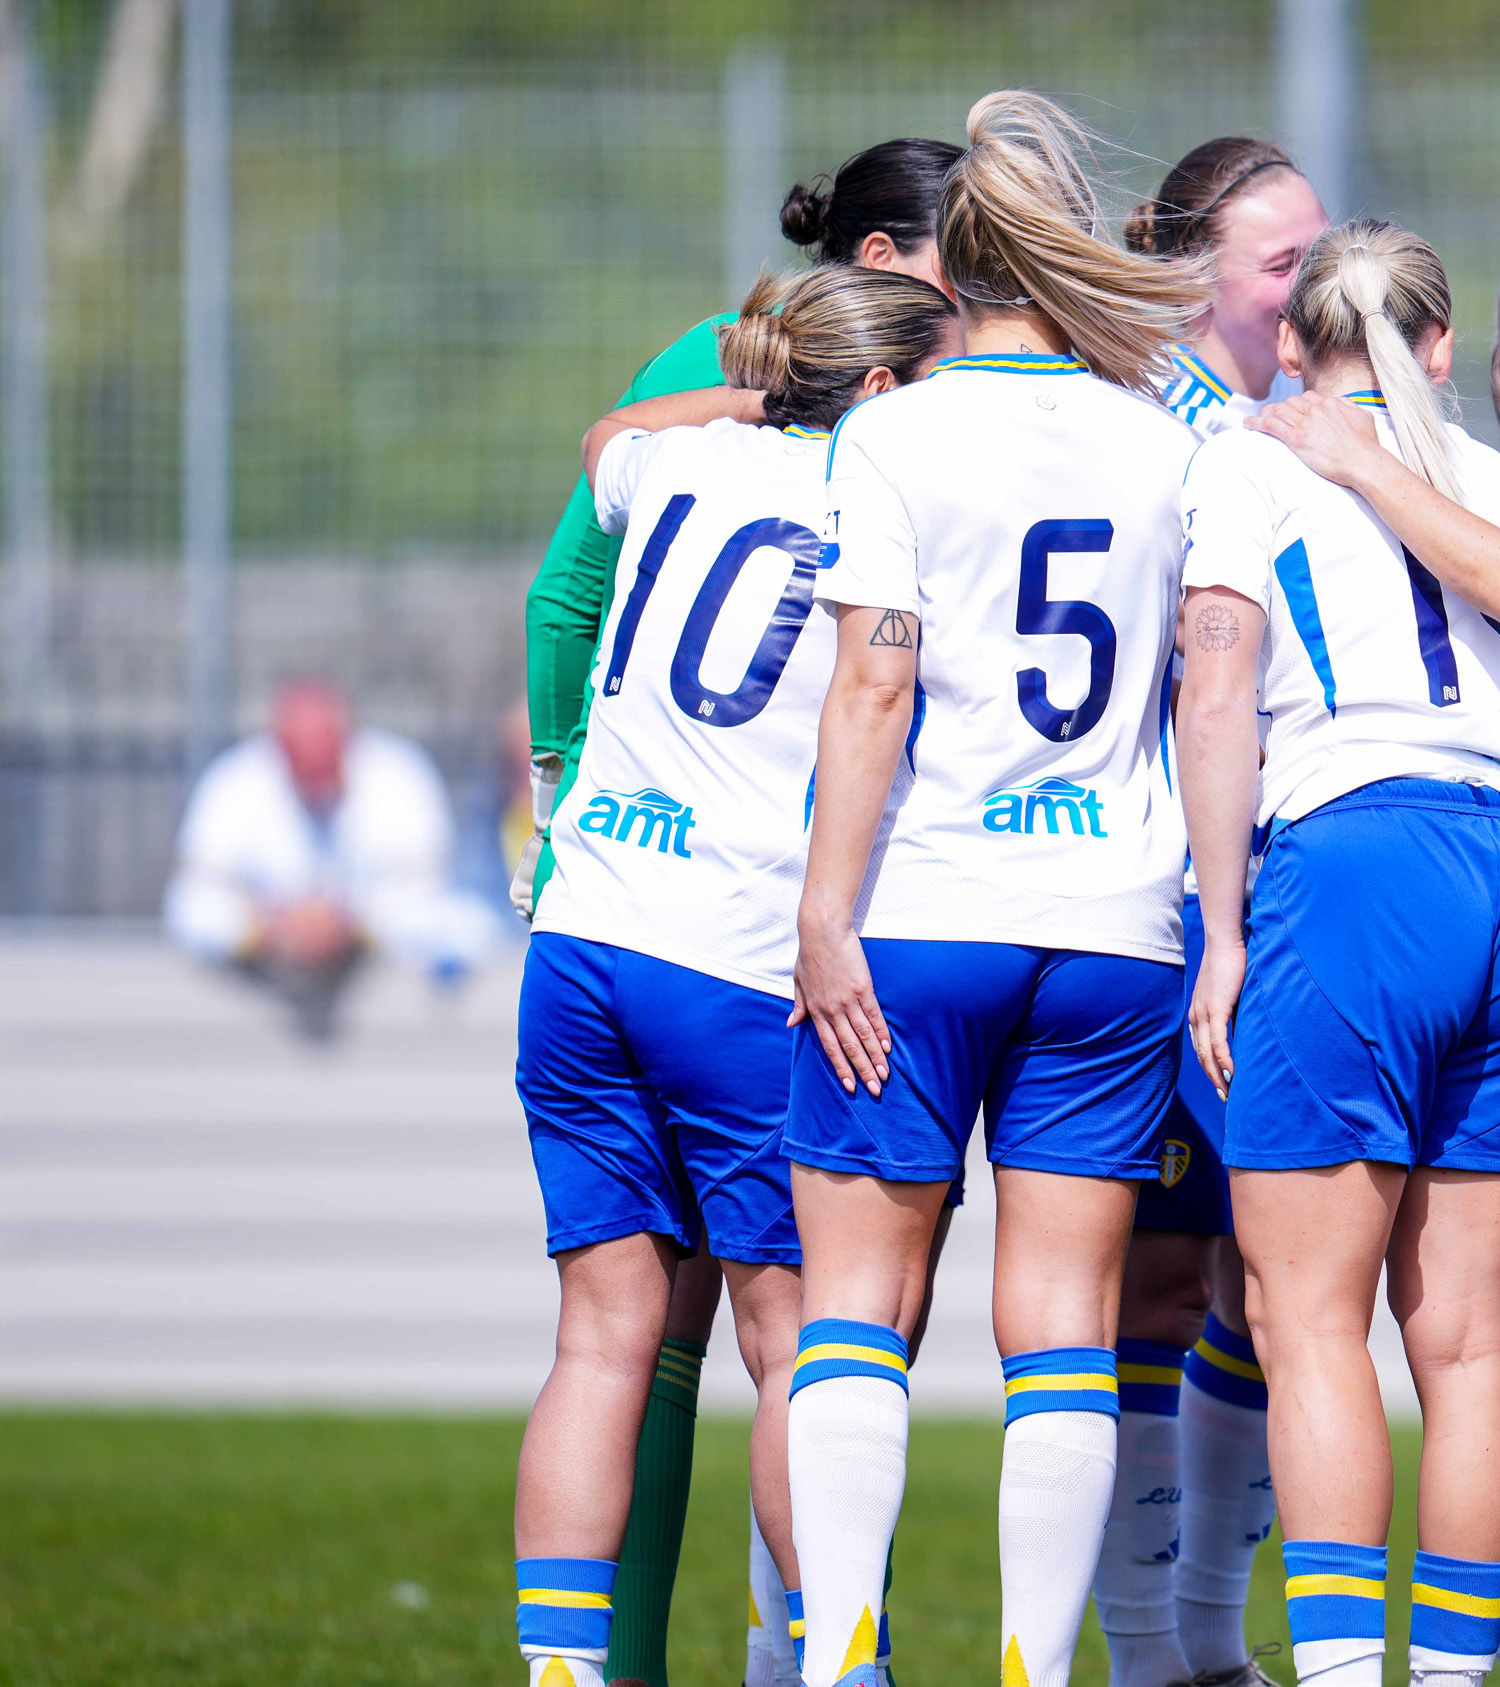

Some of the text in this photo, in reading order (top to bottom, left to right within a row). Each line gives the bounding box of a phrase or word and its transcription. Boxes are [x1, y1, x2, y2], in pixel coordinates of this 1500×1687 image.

[602, 493, 821, 727] 10
[1016, 518, 1117, 743] 5
[578, 795, 697, 860] amt
[982, 789, 1109, 838] amt
